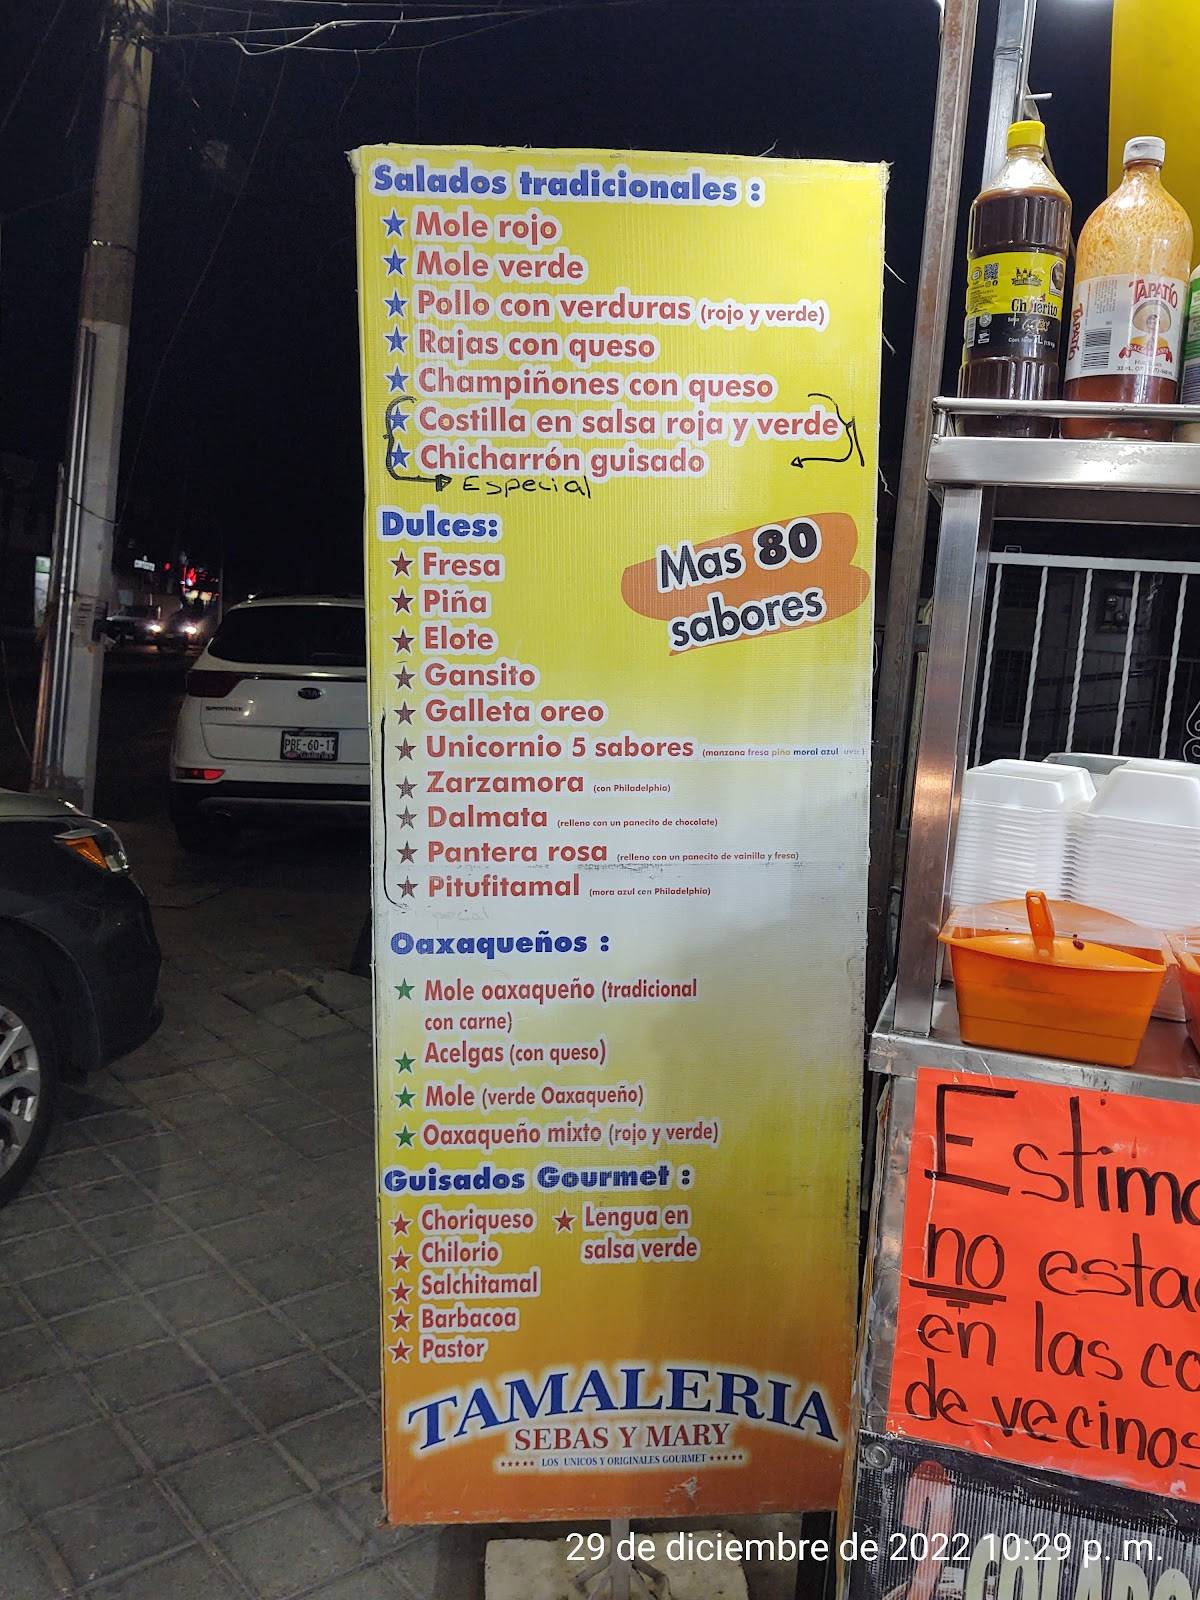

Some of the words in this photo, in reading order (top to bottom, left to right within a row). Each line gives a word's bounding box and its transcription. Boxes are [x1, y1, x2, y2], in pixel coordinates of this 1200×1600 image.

[373, 164, 508, 196] Salados
[520, 169, 738, 201] tradicionales
[415, 211, 489, 238] Mole
[499, 214, 558, 246] rojo
[416, 251, 489, 277] Mole
[499, 253, 584, 279] verde
[417, 289, 490, 317] Pollo
[500, 297, 551, 318] con
[560, 292, 692, 321] verduras
[700, 302, 744, 324] (rojo
[749, 307, 761, 327] y
[765, 303, 827, 326] verde)
[418, 328, 499, 361] Rajas
[508, 333, 558, 356] con
[569, 337, 656, 363] queso
[418, 367, 619, 401] Champiñones
[628, 375, 678, 397] con
[688, 377, 774, 401] queso
[418, 406, 527, 433] Costilla
[536, 412, 577, 434] en
[581, 407, 657, 434] salsa
[667, 410, 725, 442] roja
[733, 416, 750, 442] y
[756, 409, 840, 437] verde
[420, 444, 581, 471] Chicharrón
[590, 448, 705, 478] guisado
[462, 474, 591, 499] Especial
[382, 510, 499, 538] Dulces:
[422, 552, 501, 577] Fresa
[658, 544, 742, 593] Mas
[757, 522, 818, 566] 80
[422, 589, 487, 614] Piña
[672, 589, 823, 647] sabores
[423, 625, 494, 651] Elote
[424, 661, 536, 688] Gansito
[425, 699, 531, 724] Galleta
[541, 703, 605, 723] oreo
[426, 735, 562, 760] Unicornio
[571, 737, 586, 759] 5
[594, 737, 694, 759] sabores
[702, 748, 746, 758] (manzana
[748, 747, 769, 757] fresa
[793, 747, 818, 757] moral
[821, 747, 839, 757] azul
[426, 771, 584, 794] Zarzamora
[593, 782, 612, 795] (con
[613, 782, 671, 795] Philadelphia)
[427, 805, 548, 829] Dalmata
[557, 816, 591, 829] (relleno
[592, 818, 607, 829] con
[609, 818, 621, 829] un
[623, 817, 660, 830] panecito
[662, 816, 673, 828] de
[673, 816, 719, 829] chocolate)
[427, 841, 539, 864] Pantera
[548, 843, 608, 865] rosa
[616, 851, 651, 863] (relleno
[652, 852, 667, 862] con
[669, 852, 681, 862] un
[682, 851, 718, 863] panecito
[720, 850, 732, 862] de
[733, 850, 766, 862] vainilla
[767, 851, 773, 862] y
[774, 850, 799, 862] fresa)
[428, 873, 581, 898] Pitufitamal
[588, 885, 614, 897] (mora
[616, 885, 636, 896] azul
[637, 886, 652, 896] con
[653, 884, 712, 897] Philadelphia)
[391, 930, 588, 960] Oaxaqueños
[424, 978, 475, 1001] Mole
[481, 978, 595, 1005] oaxaqueño
[601, 978, 698, 1001] (tradicional
[424, 1015, 454, 1031] con
[459, 1011, 514, 1034] carne)
[424, 1041, 505, 1068] Acelgas
[509, 1043, 545, 1066] (con
[549, 1039, 607, 1065] queso)
[425, 1085, 476, 1107] Mole
[482, 1086, 536, 1109] (verde
[541, 1084, 644, 1110] Oaxaqueño)
[423, 1122, 541, 1150] Oaxaqueño
[547, 1123, 602, 1144] mixto
[608, 1124, 649, 1147] (rojo
[652, 1128, 661, 1147] y
[667, 1122, 719, 1145] verde)
[384, 1166, 525, 1192] Guisados
[537, 1164, 670, 1189] Gourmet
[421, 1210, 534, 1236] Choriqueso
[585, 1206, 658, 1232] Lengua
[664, 1209, 689, 1227] en
[422, 1241, 499, 1263] Chilorio
[584, 1239, 635, 1262] salsa
[641, 1236, 698, 1260] verde
[927, 1223, 1006, 1291] no
[422, 1272, 539, 1297] Salchitamal
[422, 1308, 517, 1330] Barbacoa
[422, 1339, 485, 1360] Pastor
[918, 1312, 998, 1367] en
[1034, 1300, 1124, 1381] las
[905, 1358, 974, 1427] de
[407, 1367, 840, 1451] TAMALERIA
[514, 1425, 609, 1452] SEBAS
[618, 1425, 639, 1449] Y
[646, 1422, 731, 1448] MARY
[541, 1457, 559, 1468] LOS
[563, 1456, 598, 1467] UNICOS
[599, 1457, 606, 1466] Y
[607, 1455, 660, 1467] ORIGINALES
[662, 1453, 707, 1465] GOURMET
